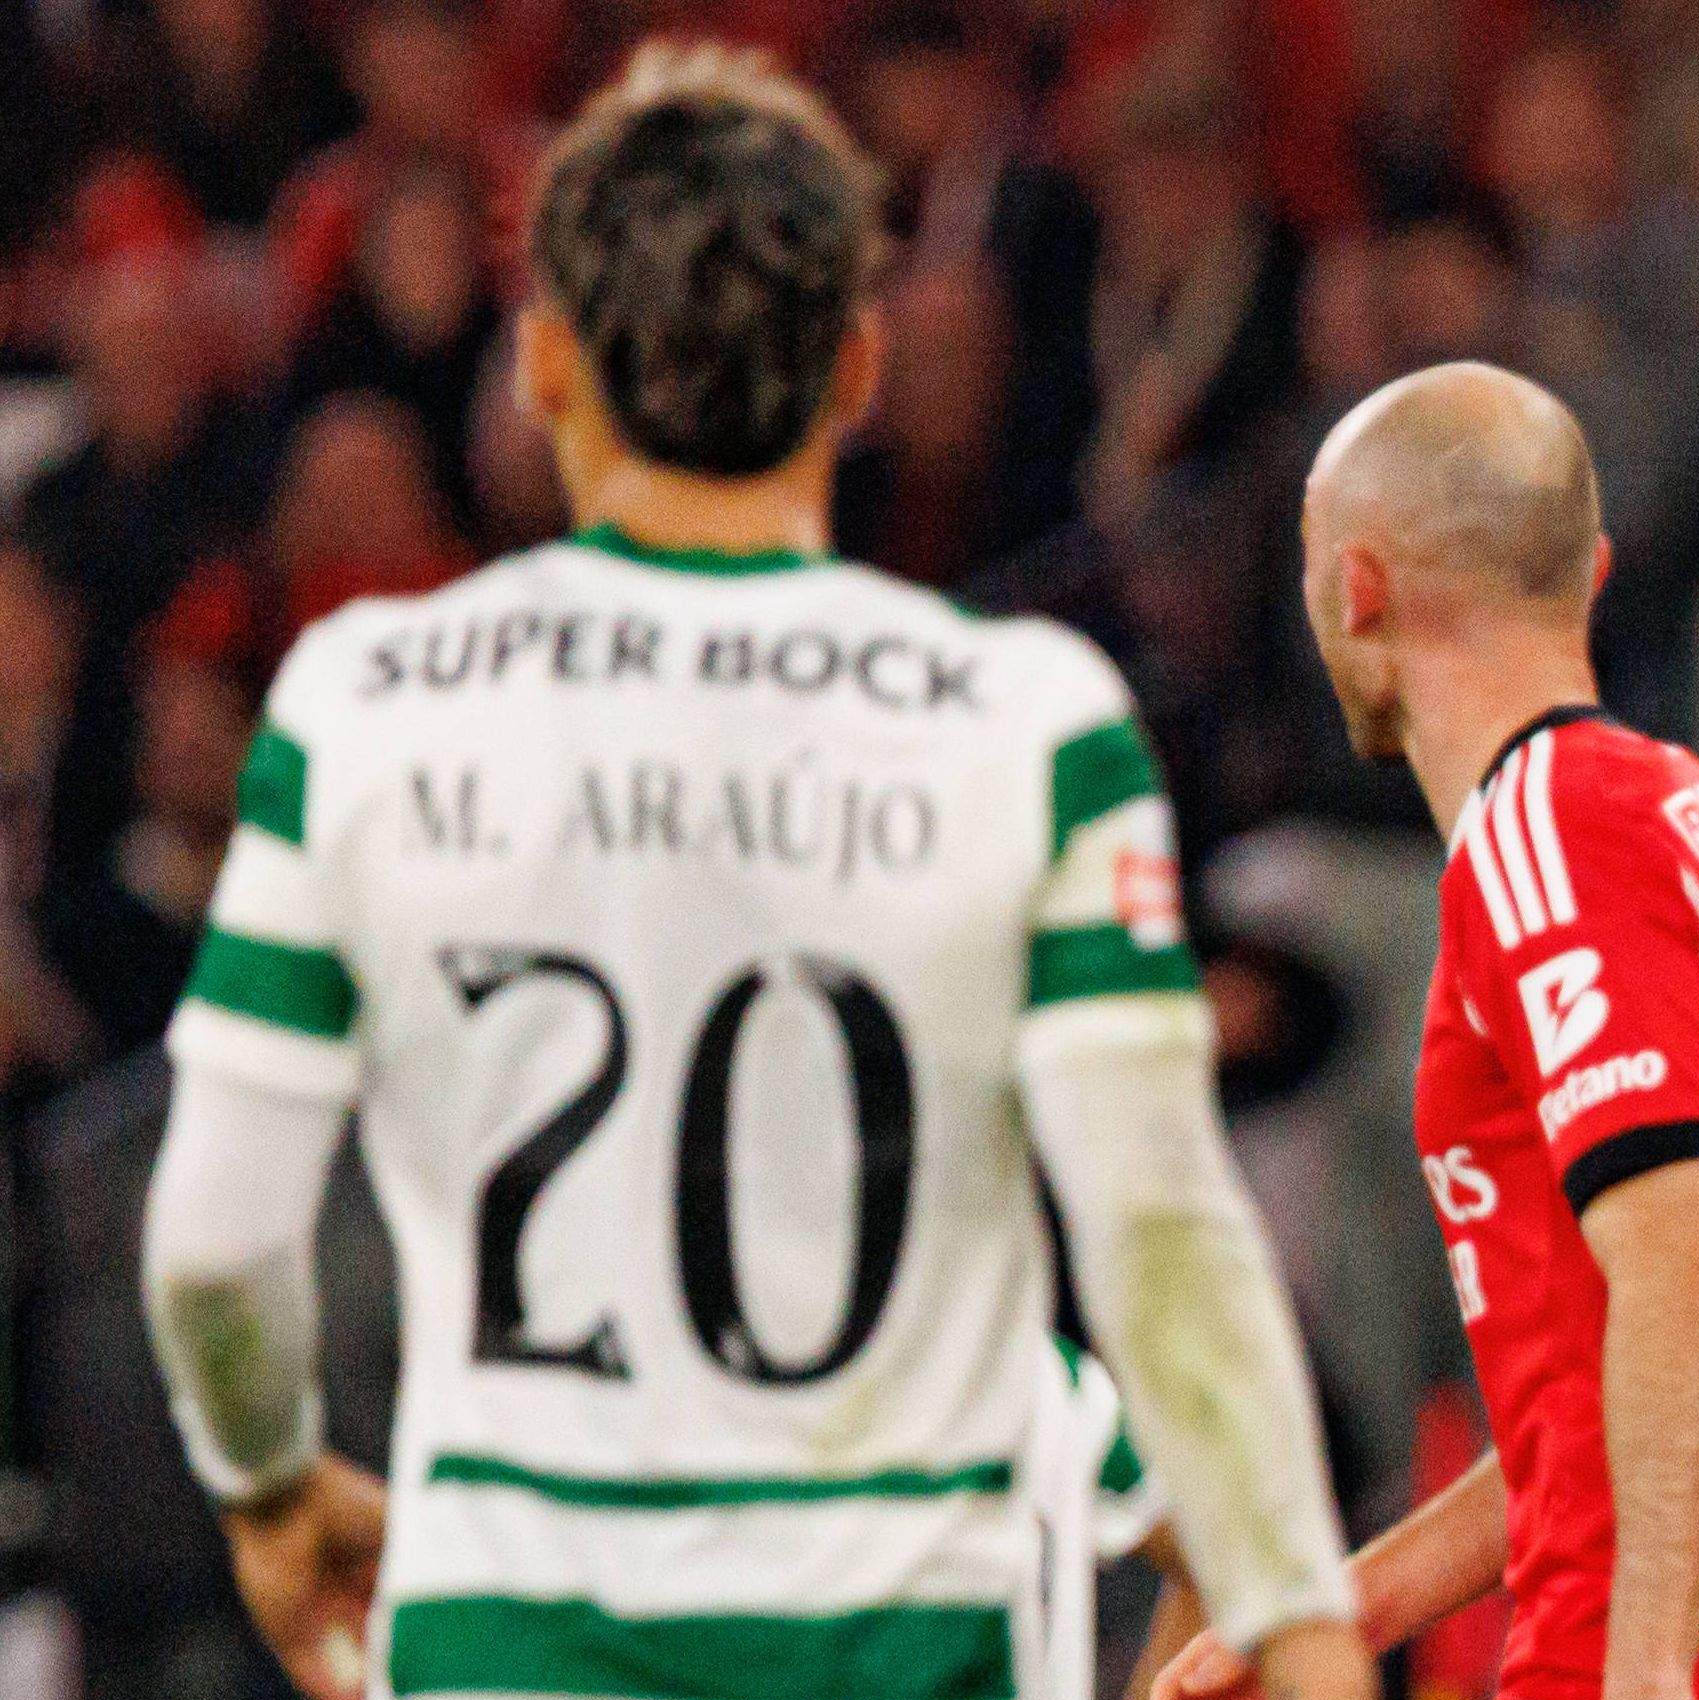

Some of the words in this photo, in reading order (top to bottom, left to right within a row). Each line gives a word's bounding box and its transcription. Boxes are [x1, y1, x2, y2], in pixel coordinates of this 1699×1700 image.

[364, 605, 662, 702] SUPER
[698, 624, 980, 714] BOCK
[406, 762, 508, 856] M.
[552, 746, 938, 888] ARAÚJO
[435, 943, 917, 1392] 20
